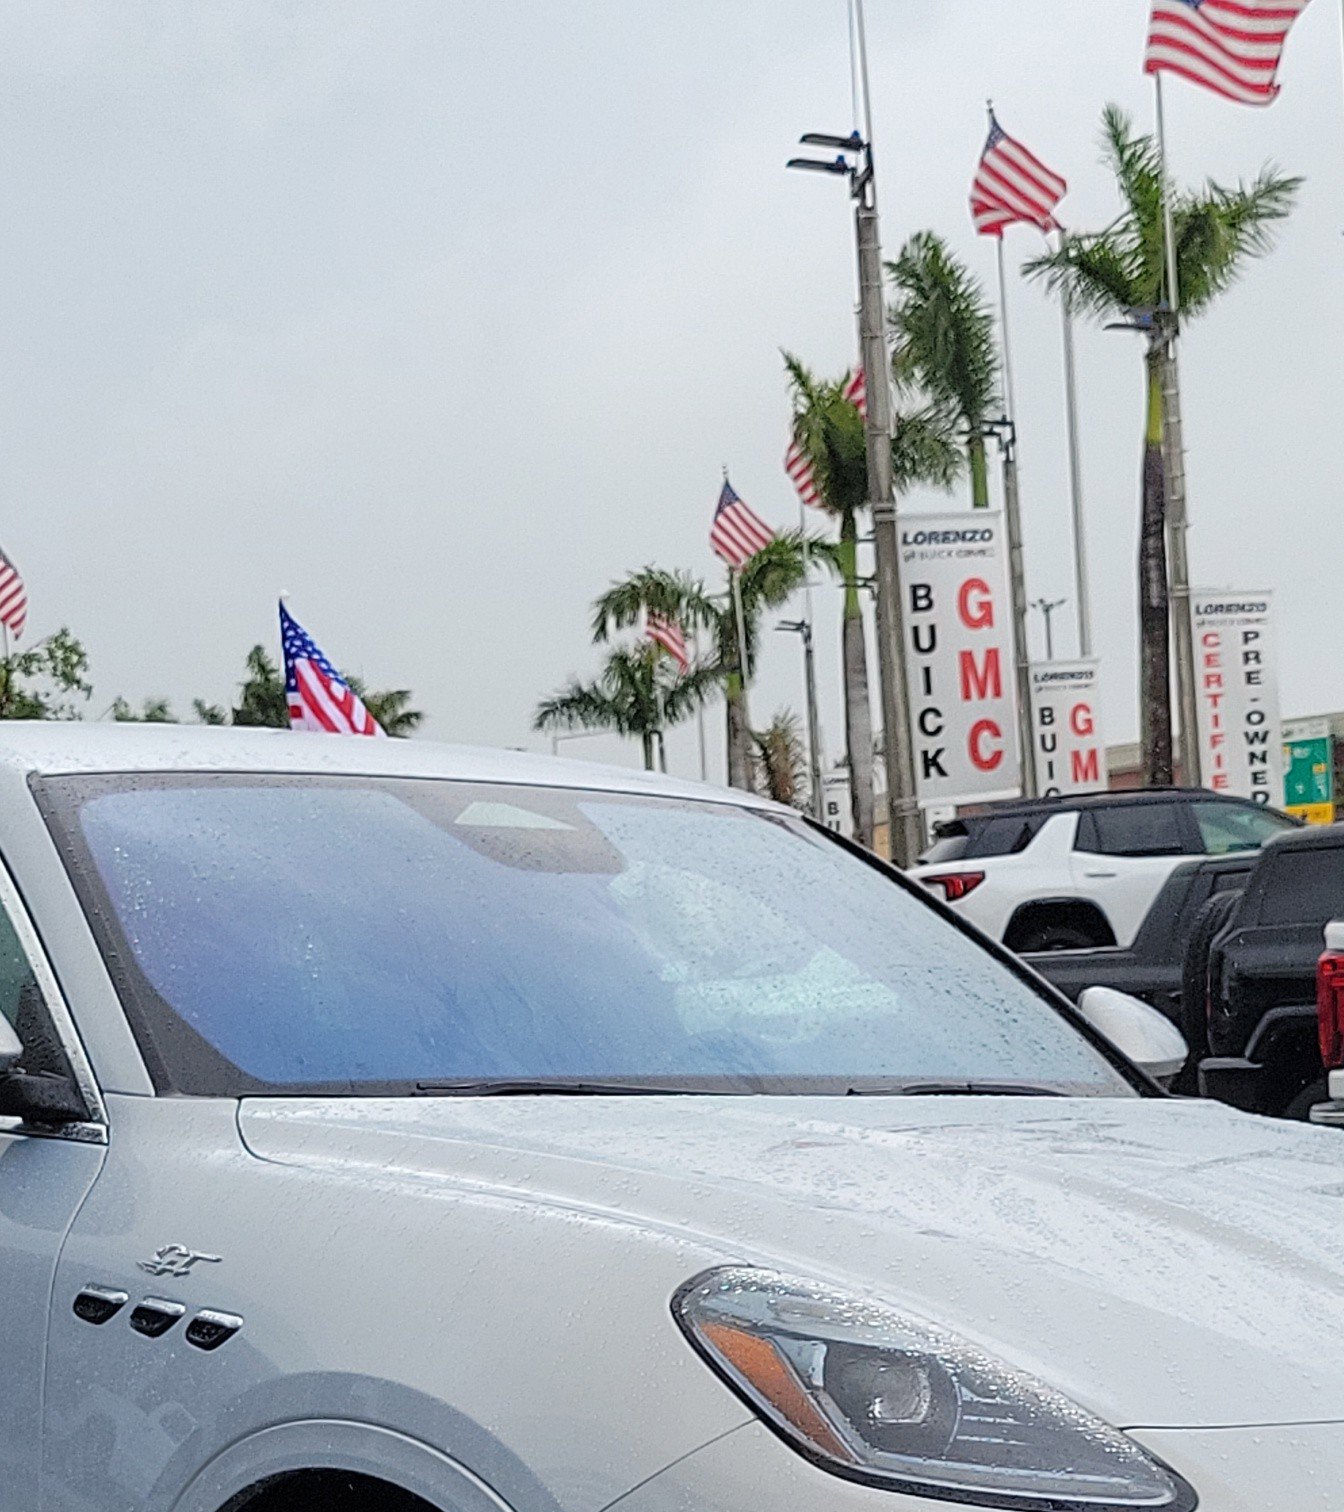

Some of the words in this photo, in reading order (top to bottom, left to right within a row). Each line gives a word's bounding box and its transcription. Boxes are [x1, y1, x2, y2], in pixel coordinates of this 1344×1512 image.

[901, 528, 994, 546] LORENZO
[909, 583, 949, 780] BUICK
[957, 577, 1003, 773] GMC
[1202, 633, 1230, 790] CERTIFIE
[1039, 706, 1061, 799] BUI
[1069, 703, 1099, 783] GM
